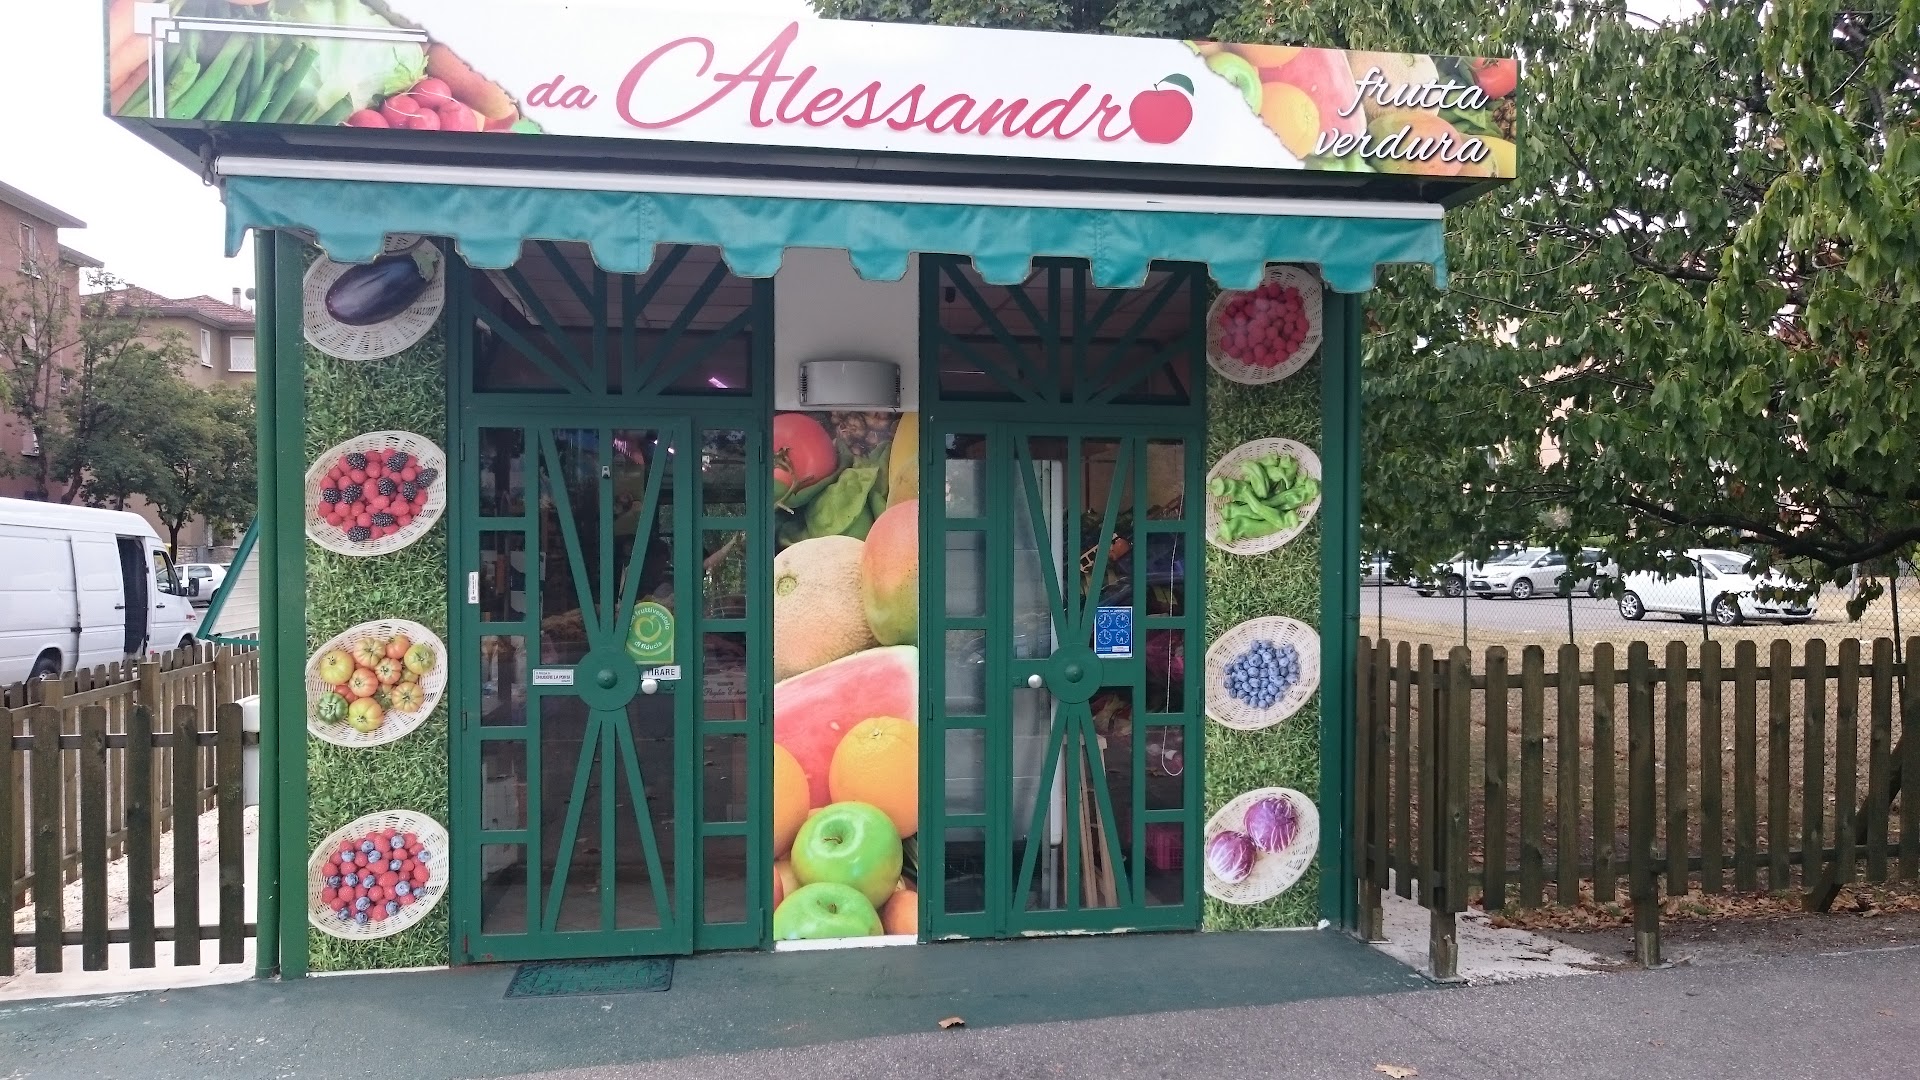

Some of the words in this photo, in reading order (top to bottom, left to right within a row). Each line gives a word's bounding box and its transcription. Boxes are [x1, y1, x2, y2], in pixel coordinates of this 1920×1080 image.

[526, 74, 597, 110] da
[1337, 66, 1490, 117] frutta
[1314, 125, 1490, 163] verdura
[634, 606, 671, 630] fruttivendolo
[641, 641, 662, 650] fiducia
